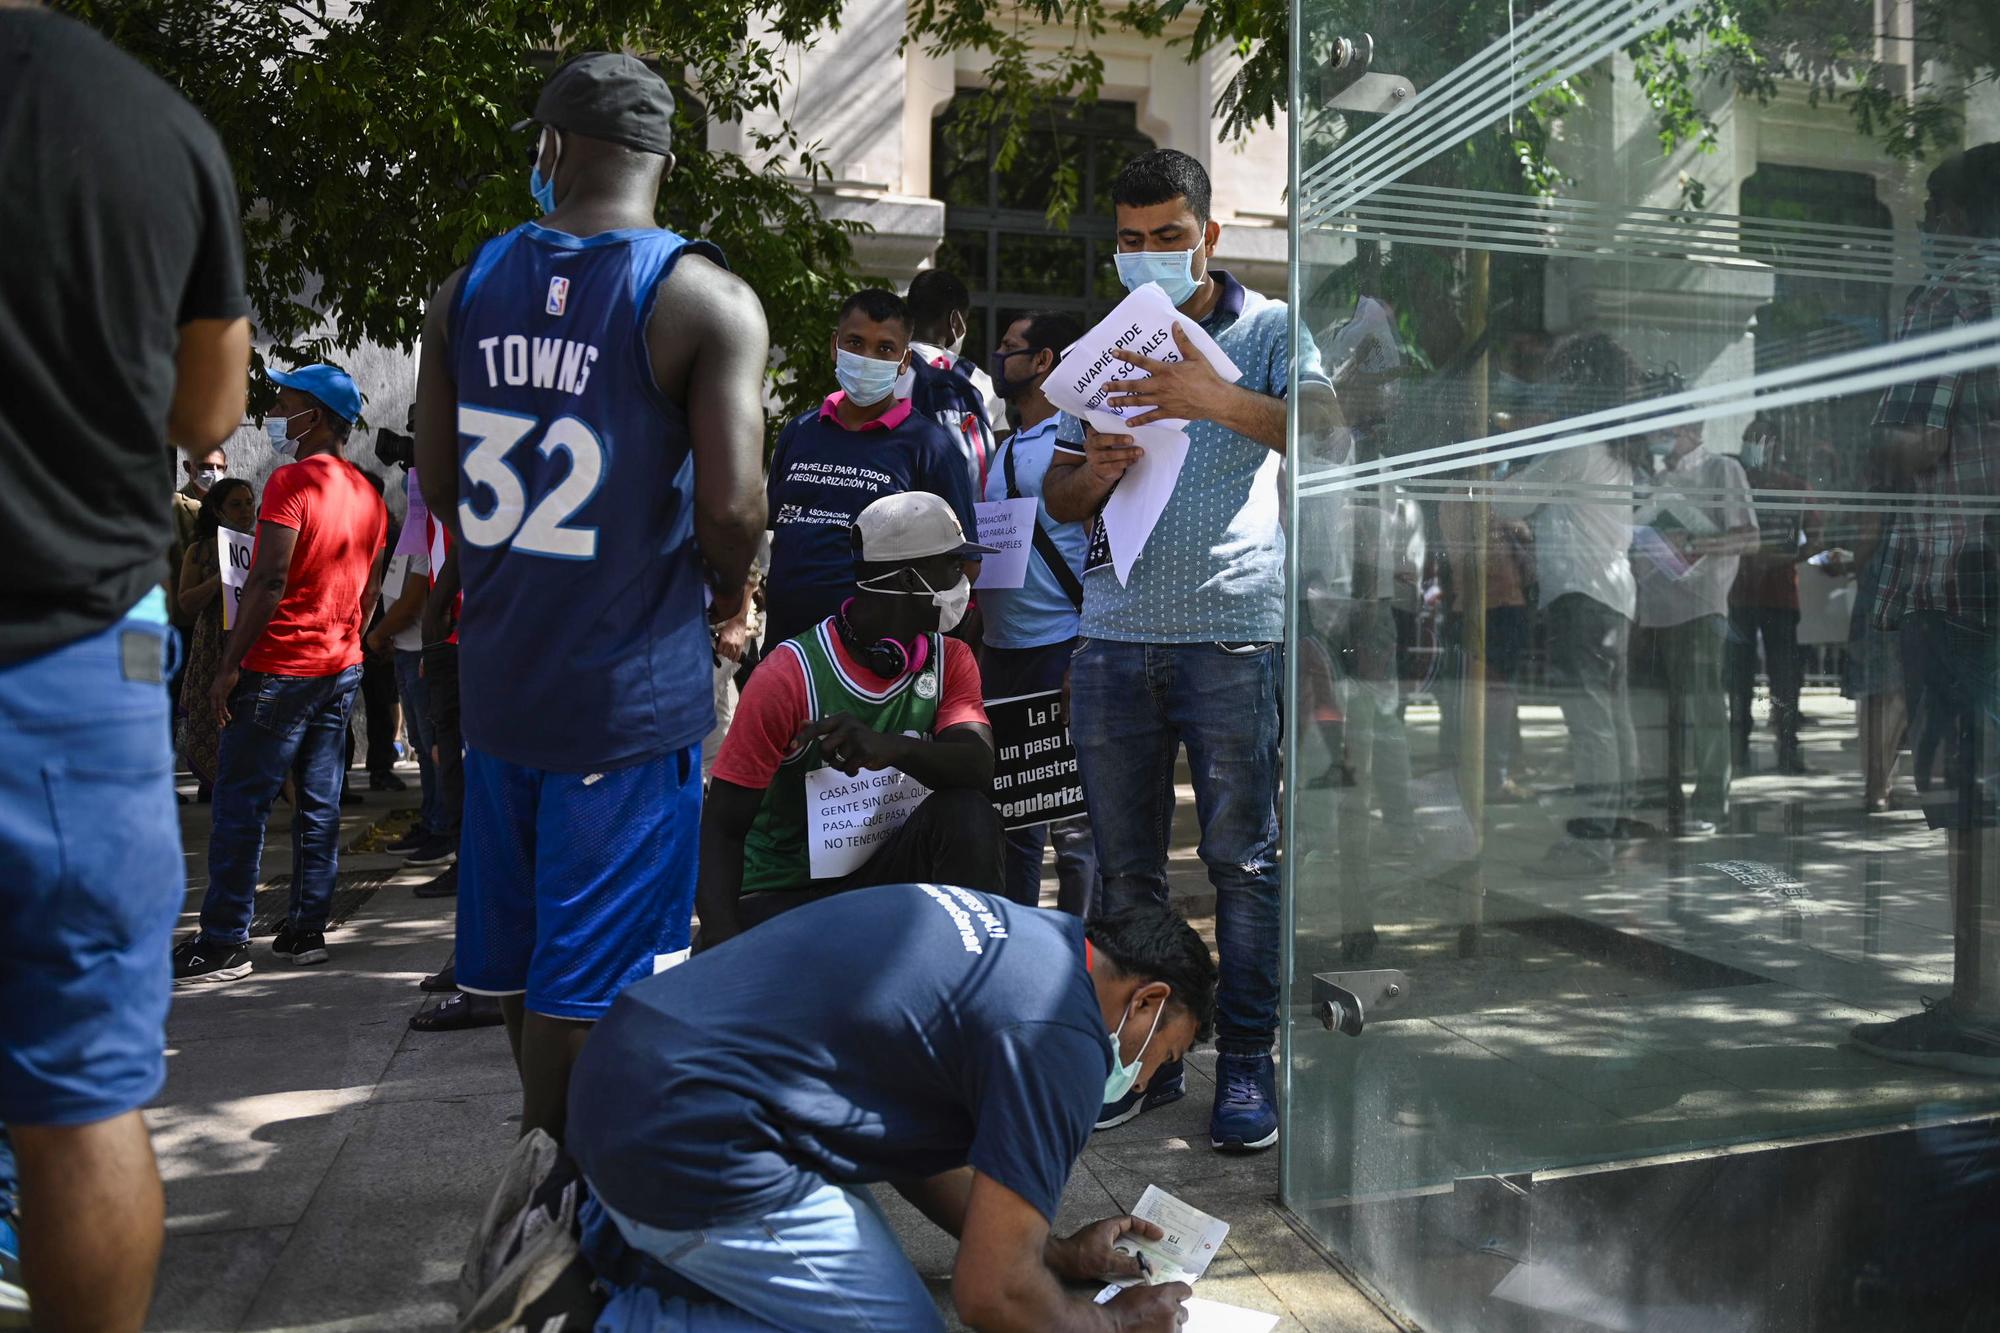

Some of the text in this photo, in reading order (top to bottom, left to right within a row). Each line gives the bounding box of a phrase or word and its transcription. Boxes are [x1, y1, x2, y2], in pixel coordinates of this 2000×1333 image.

[1115, 323, 1143, 350] PIDE
[478, 335, 599, 396] TOWNS
[1085, 375, 1119, 410] MEDIDS
[1118, 328, 1169, 378] SOALES
[458, 403, 605, 560] 32
[834, 465, 857, 476] PARA
[859, 468, 891, 484] TODOS
[866, 481, 878, 493] YA
[826, 518, 850, 528] BANGL
[976, 511, 1008, 526] ORMACIÓN
[990, 527, 1005, 537] PARA
[1005, 526, 1017, 535] LAS
[995, 539, 1023, 550] PAPELES
[229, 542, 251, 571] NO
[1028, 702, 1061, 727] La P
[1000, 745, 1020, 761] un
[1024, 735, 1061, 760] paso
[819, 786, 849, 801] CASA
[852, 780, 869, 794] SIN
[993, 774, 1013, 791] en
[821, 802, 860, 816] GENTE
[863, 796, 880, 809] SIN
[992, 785, 1085, 818] egulariza
[824, 837, 843, 849] NO
[846, 830, 890, 847] TENEMOS
